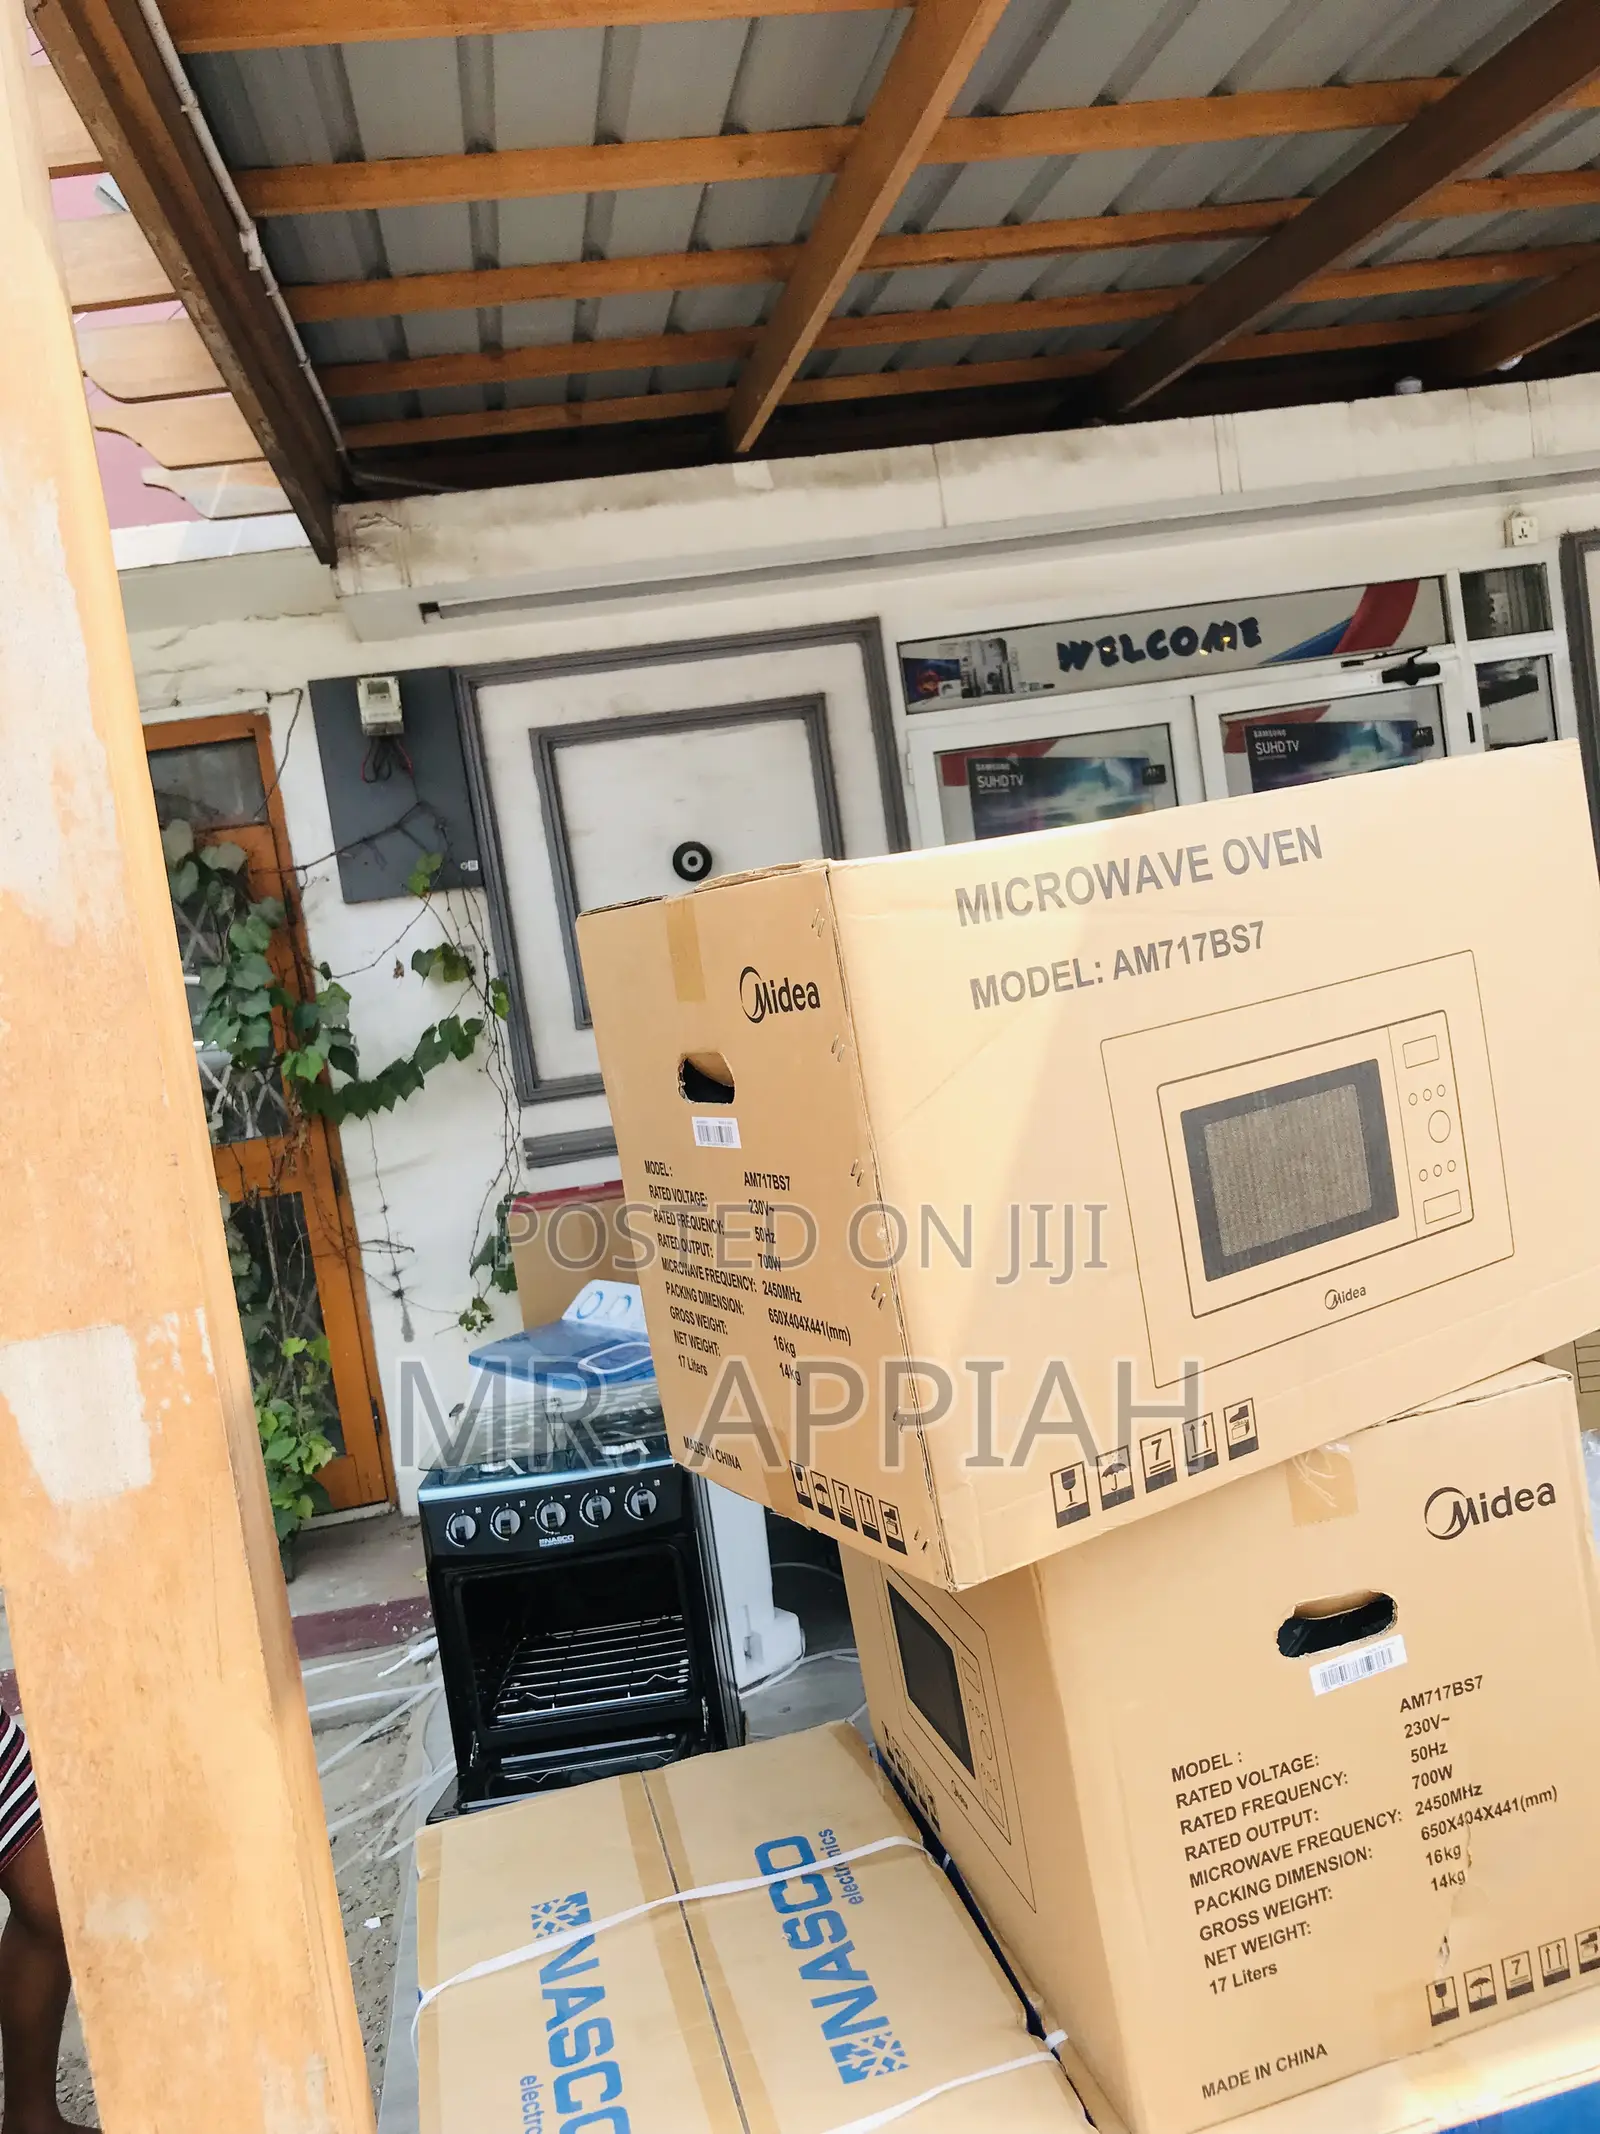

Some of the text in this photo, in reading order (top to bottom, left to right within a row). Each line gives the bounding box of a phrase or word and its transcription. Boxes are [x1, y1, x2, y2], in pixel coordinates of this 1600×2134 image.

[1056, 616, 1263, 673] WELCOME
[955, 824, 1323, 927] MICROWAVE OVEN
[969, 920, 1264, 1010] MODEL: AM717BS7
[739, 966, 820, 1024] Midea
[648, 1185, 708, 1207] RATED VOLTAGE:
[743, 1171, 790, 1191] AM717BS7
[653, 1209, 725, 1236] RATED FREQUENCY:
[754, 1227, 776, 1244] 50Hz
[657, 1233, 714, 1258] RATED OUTPUT:
[758, 1253, 782, 1272] 700W
[661, 1257, 757, 1293] MICROWAVE FREQUENCY:
[762, 1281, 802, 1303] 2450MHz
[665, 1281, 745, 1315] PACKING DIMENSION:
[1325, 1286, 1366, 1310] Midea
[669, 1305, 728, 1335] GROSS WEIGHT:
[768, 1308, 851, 1346] 650X404X441(mm)
[674, 1330, 721, 1357] NET WEIGHT:
[773, 1335, 796, 1359] 16kg
[678, 1354, 708, 1376] 17 Liters
[779, 1362, 801, 1386] 14kg
[683, 1435, 705, 1457] MADE
[715, 1449, 742, 1471] CHINA
[1424, 1482, 1557, 1541] Midea
[1399, 1674, 1483, 1713] AM717BS7
[1404, 1714, 1450, 1739] 230V~
[1410, 1742, 1448, 1763] 50Hz
[1175, 1753, 1320, 1809] RATED VOLTAGE:
[1412, 1764, 1453, 1790] 700W
[1180, 1771, 1348, 1835] RATED FREQUENCY:
[1415, 1783, 1483, 1816] 2450MHz
[1420, 1785, 1558, 1841] 650X404X441(mm)
[1184, 1808, 1319, 1861] RATED OUTPUT:
[1189, 1808, 1403, 1888] MICROWAVE FREQUENCY:
[818, 1828, 865, 1906] electrnics
[1425, 1844, 1462, 1866] 16kg
[1194, 1846, 1373, 1915] PACKING DIMENSION:
[1430, 1869, 1466, 1891] 14kg
[1199, 1886, 1333, 1941] GROSS WEIGHT:
[754, 1835, 890, 2042] NASCO
[1204, 1921, 1312, 1969] NET WEIGHT:
[1209, 1962, 1278, 1995] 17 Liters
[1201, 2042, 1328, 2099] MADE IN CHINA
